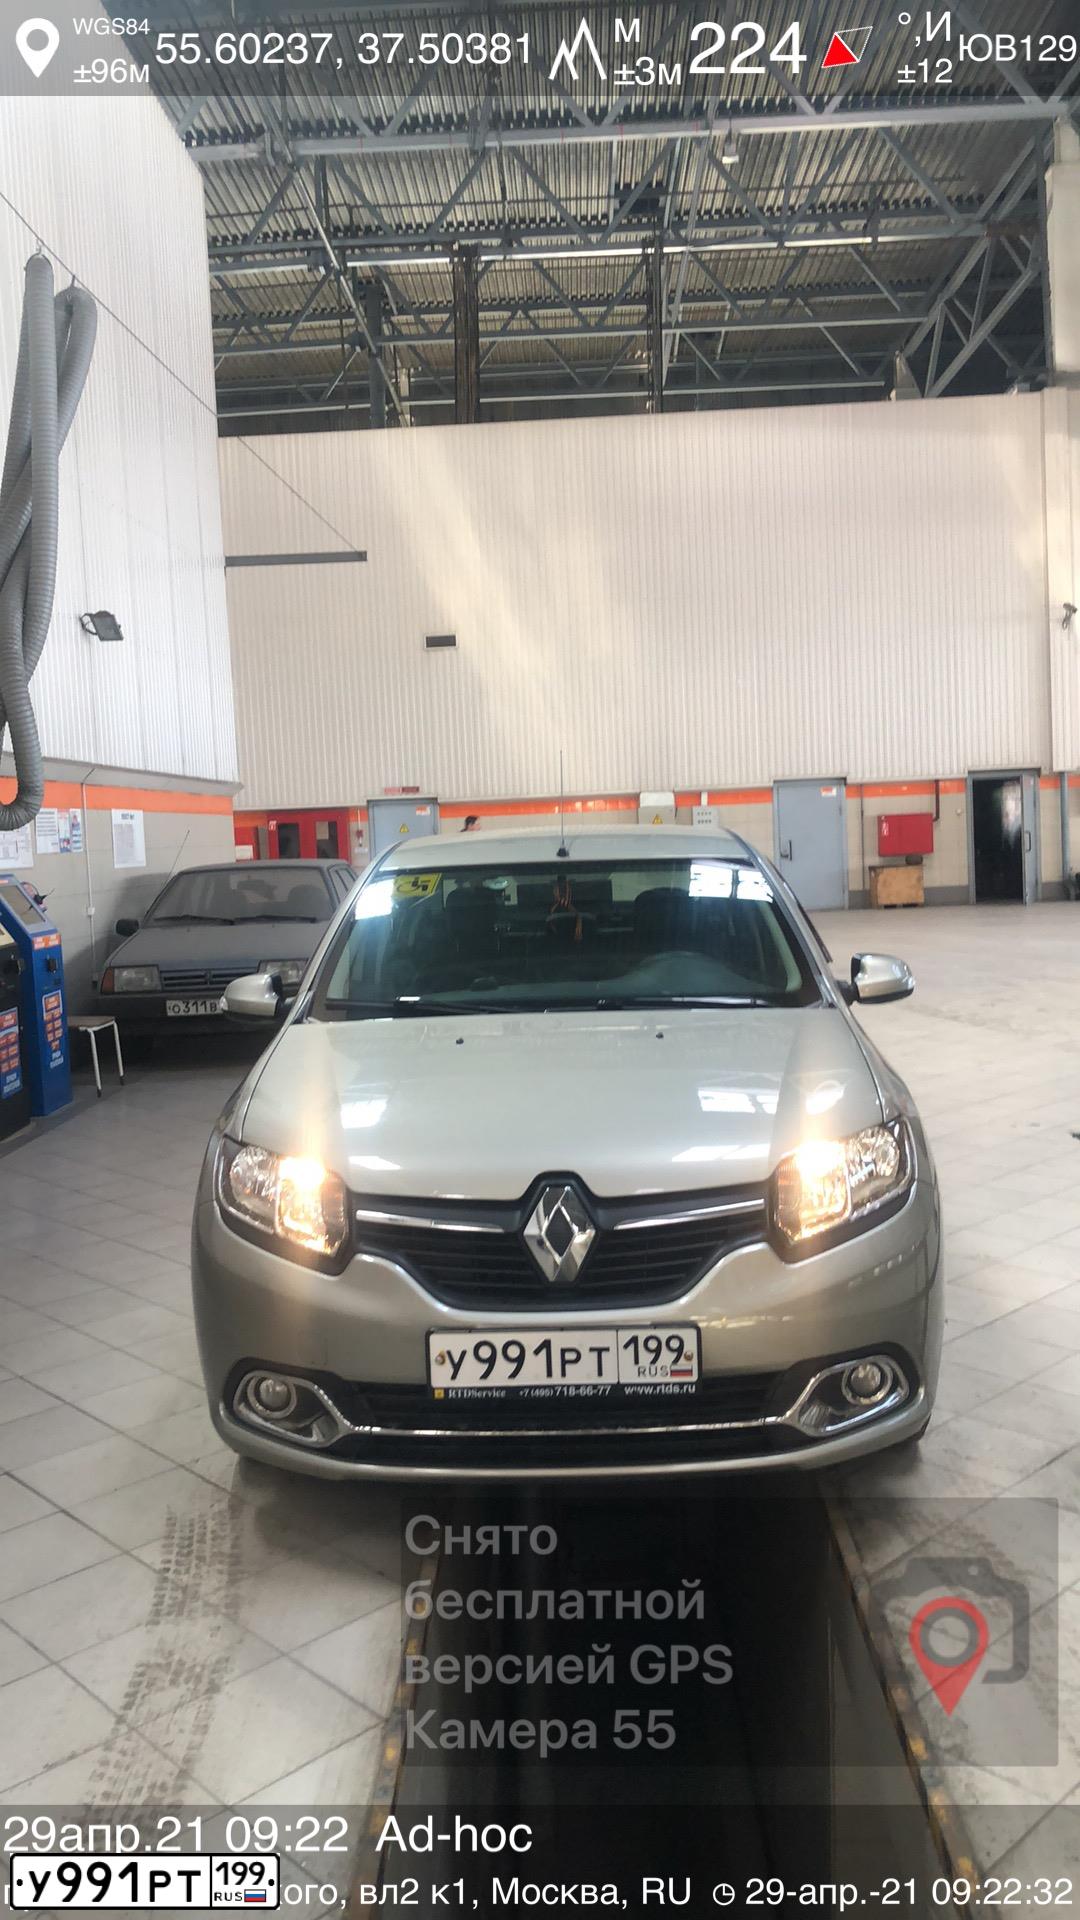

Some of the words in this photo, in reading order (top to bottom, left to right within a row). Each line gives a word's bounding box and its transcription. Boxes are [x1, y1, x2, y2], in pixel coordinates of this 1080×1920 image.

[446, 1338, 610, 1381] У991РТ
[622, 1334, 685, 1366] 199
[637, 1365, 669, 1378] RUS
